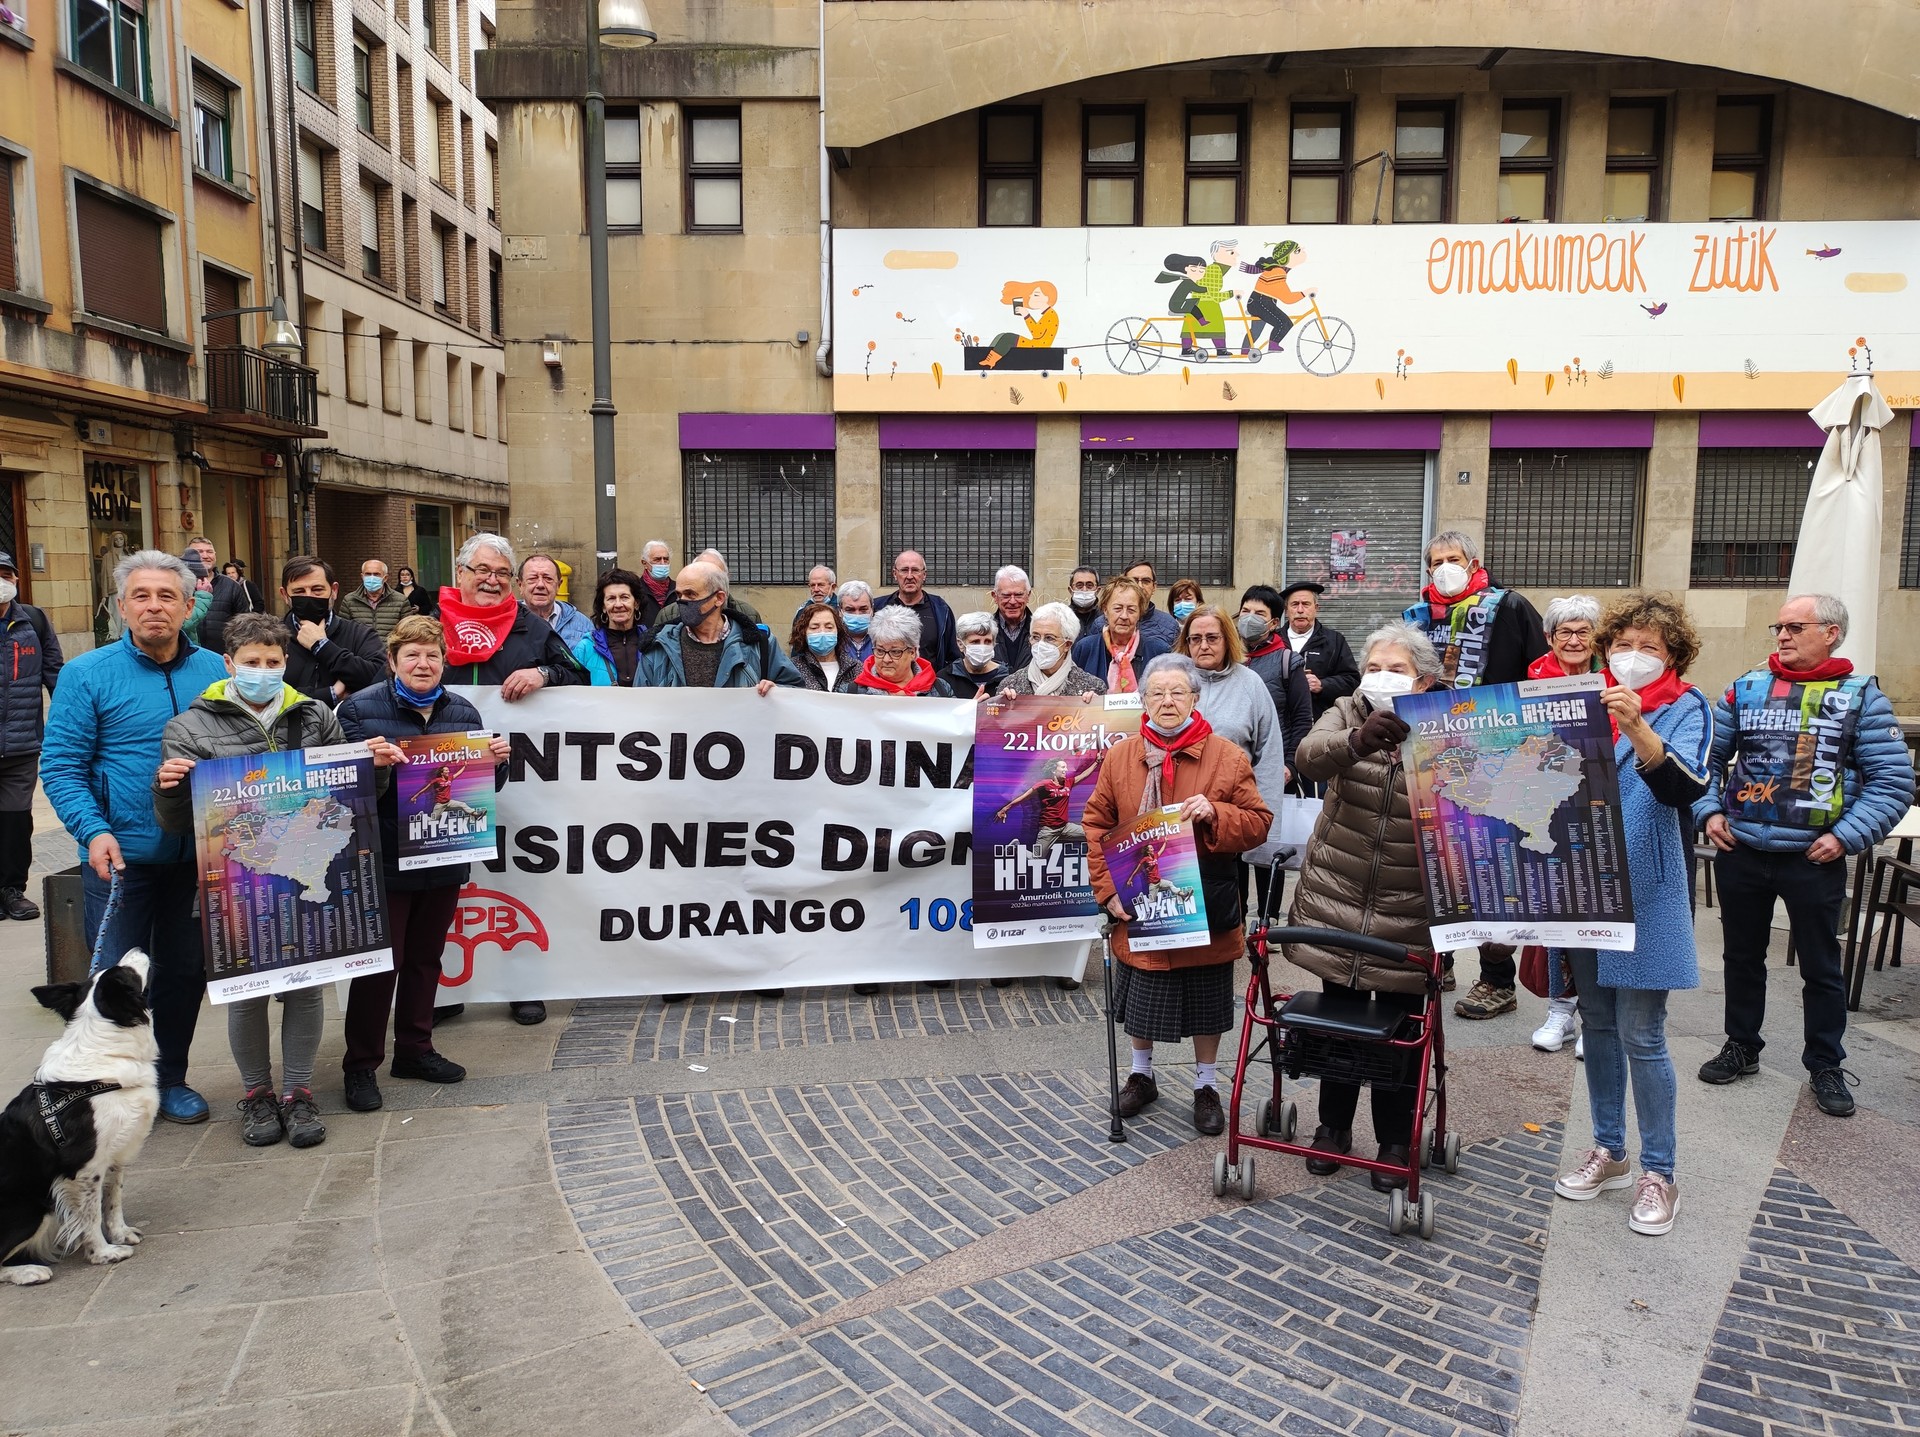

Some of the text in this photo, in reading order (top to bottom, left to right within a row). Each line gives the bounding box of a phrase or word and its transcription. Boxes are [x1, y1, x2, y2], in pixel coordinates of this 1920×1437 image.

[1426, 227, 1647, 294] emakumeak
[91, 460, 126, 491] ACT
[1460, 472, 1468, 482] 4
[88, 491, 131, 521] NOW
[1450, 698, 1478, 715] aek
[1048, 709, 1085, 732] aek
[437, 739, 457, 752] aek
[1795, 691, 1852, 811] korrika
[243, 765, 269, 782] aek
[1736, 775, 1780, 805] aek
[1136, 815, 1155, 832] aek
[600, 898, 865, 942] DURANGO
[1445, 931, 1466, 940] araba
[1577, 929, 1612, 937] oreka
[344, 957, 374, 969] oreka
[222, 984, 244, 994] araba
[249, 979, 270, 989] álava
